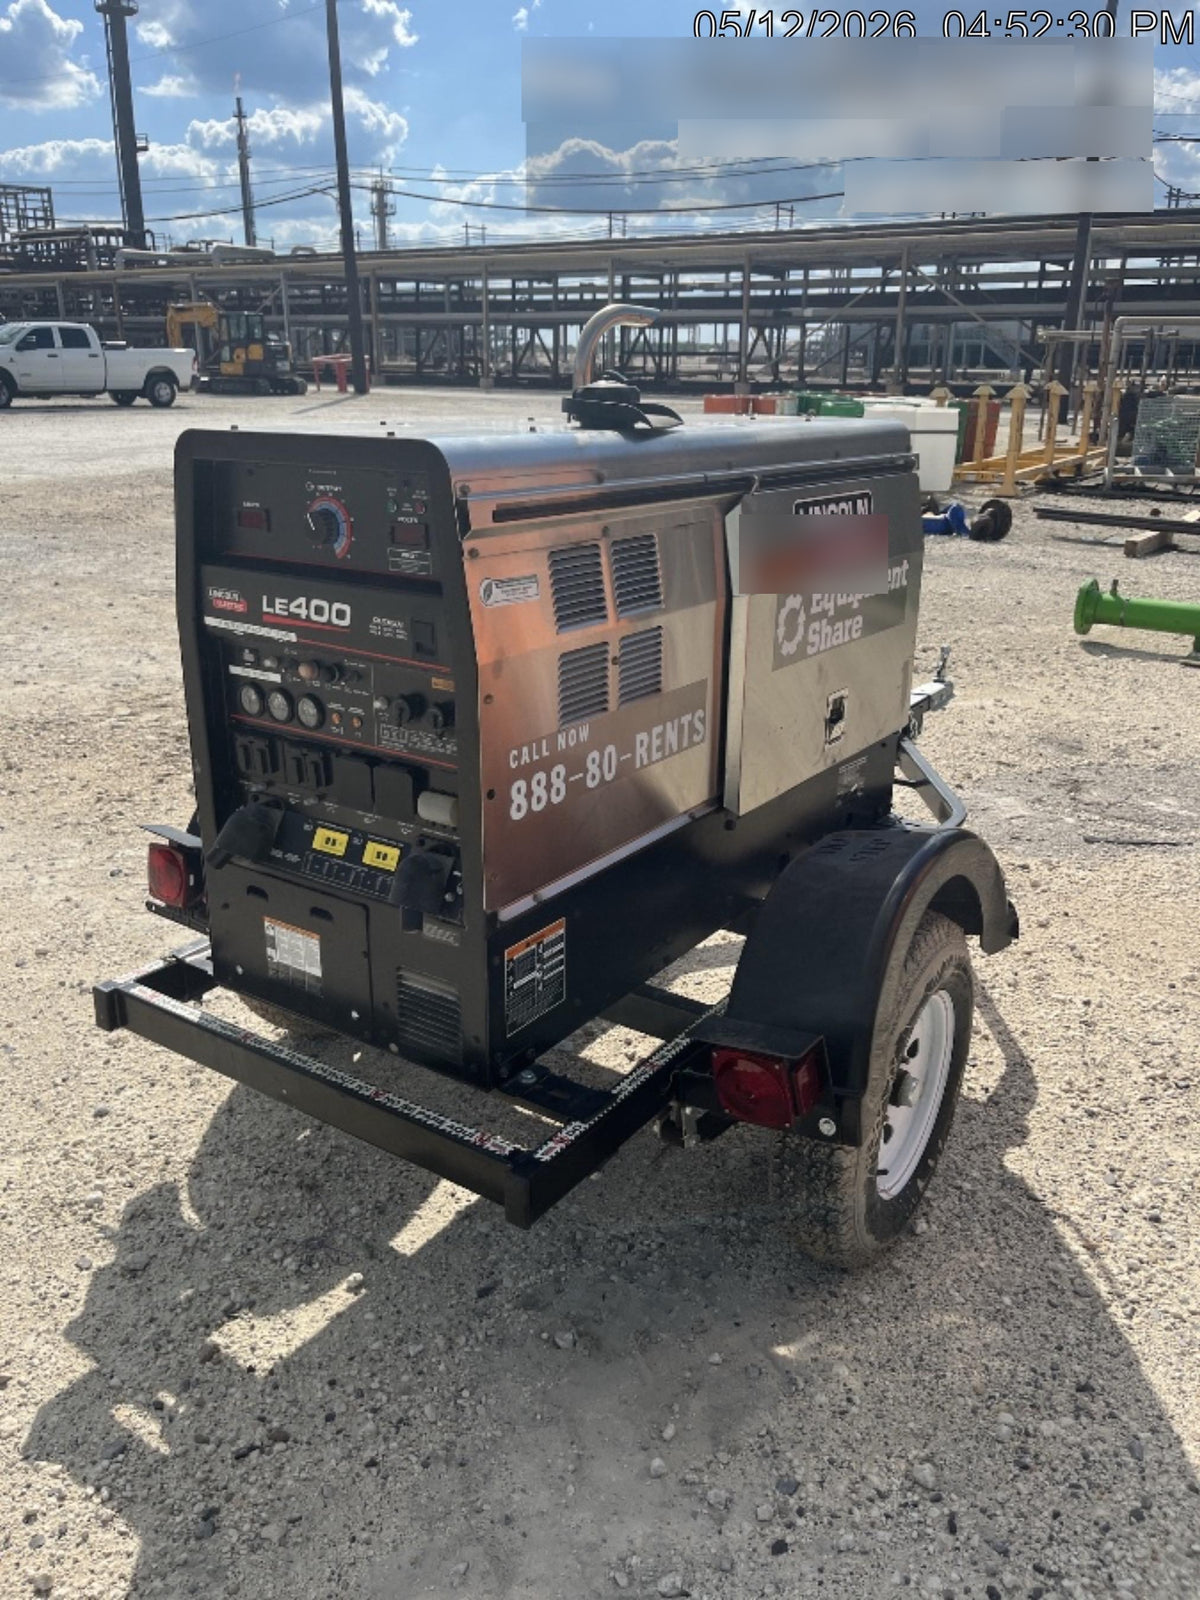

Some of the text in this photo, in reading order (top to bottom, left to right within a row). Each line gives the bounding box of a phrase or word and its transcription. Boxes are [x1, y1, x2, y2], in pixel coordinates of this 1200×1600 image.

[262, 595, 351, 627] LE400
[806, 614, 863, 655] Share
[509, 723, 590, 768] CALL NOW
[509, 709, 705, 821] 888-80-RENTS
